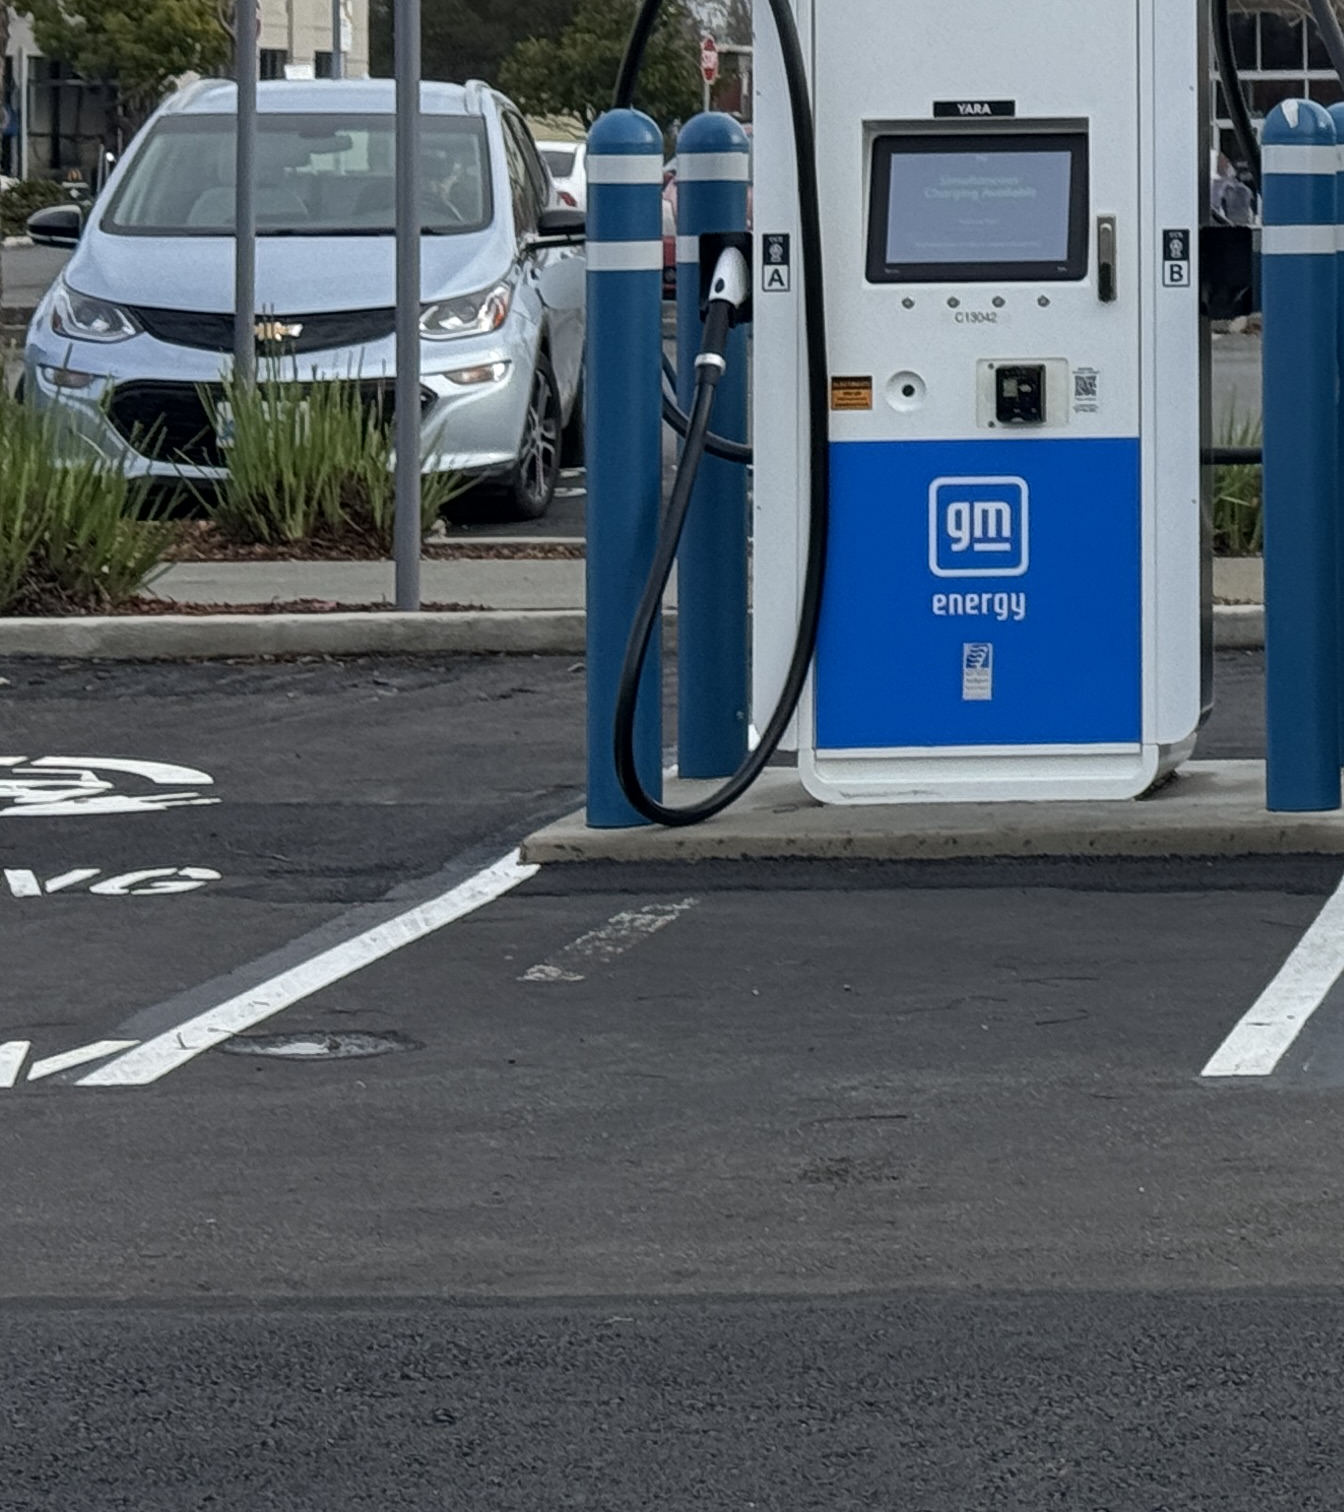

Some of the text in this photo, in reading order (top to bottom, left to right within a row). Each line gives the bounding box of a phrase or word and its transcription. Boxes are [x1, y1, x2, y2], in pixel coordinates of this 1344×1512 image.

[957, 103, 992, 115] YARA
[768, 268, 785, 287] A
[1170, 263, 1183, 283] B
[946, 500, 1012, 553] gm
[932, 591, 1026, 621] energy
